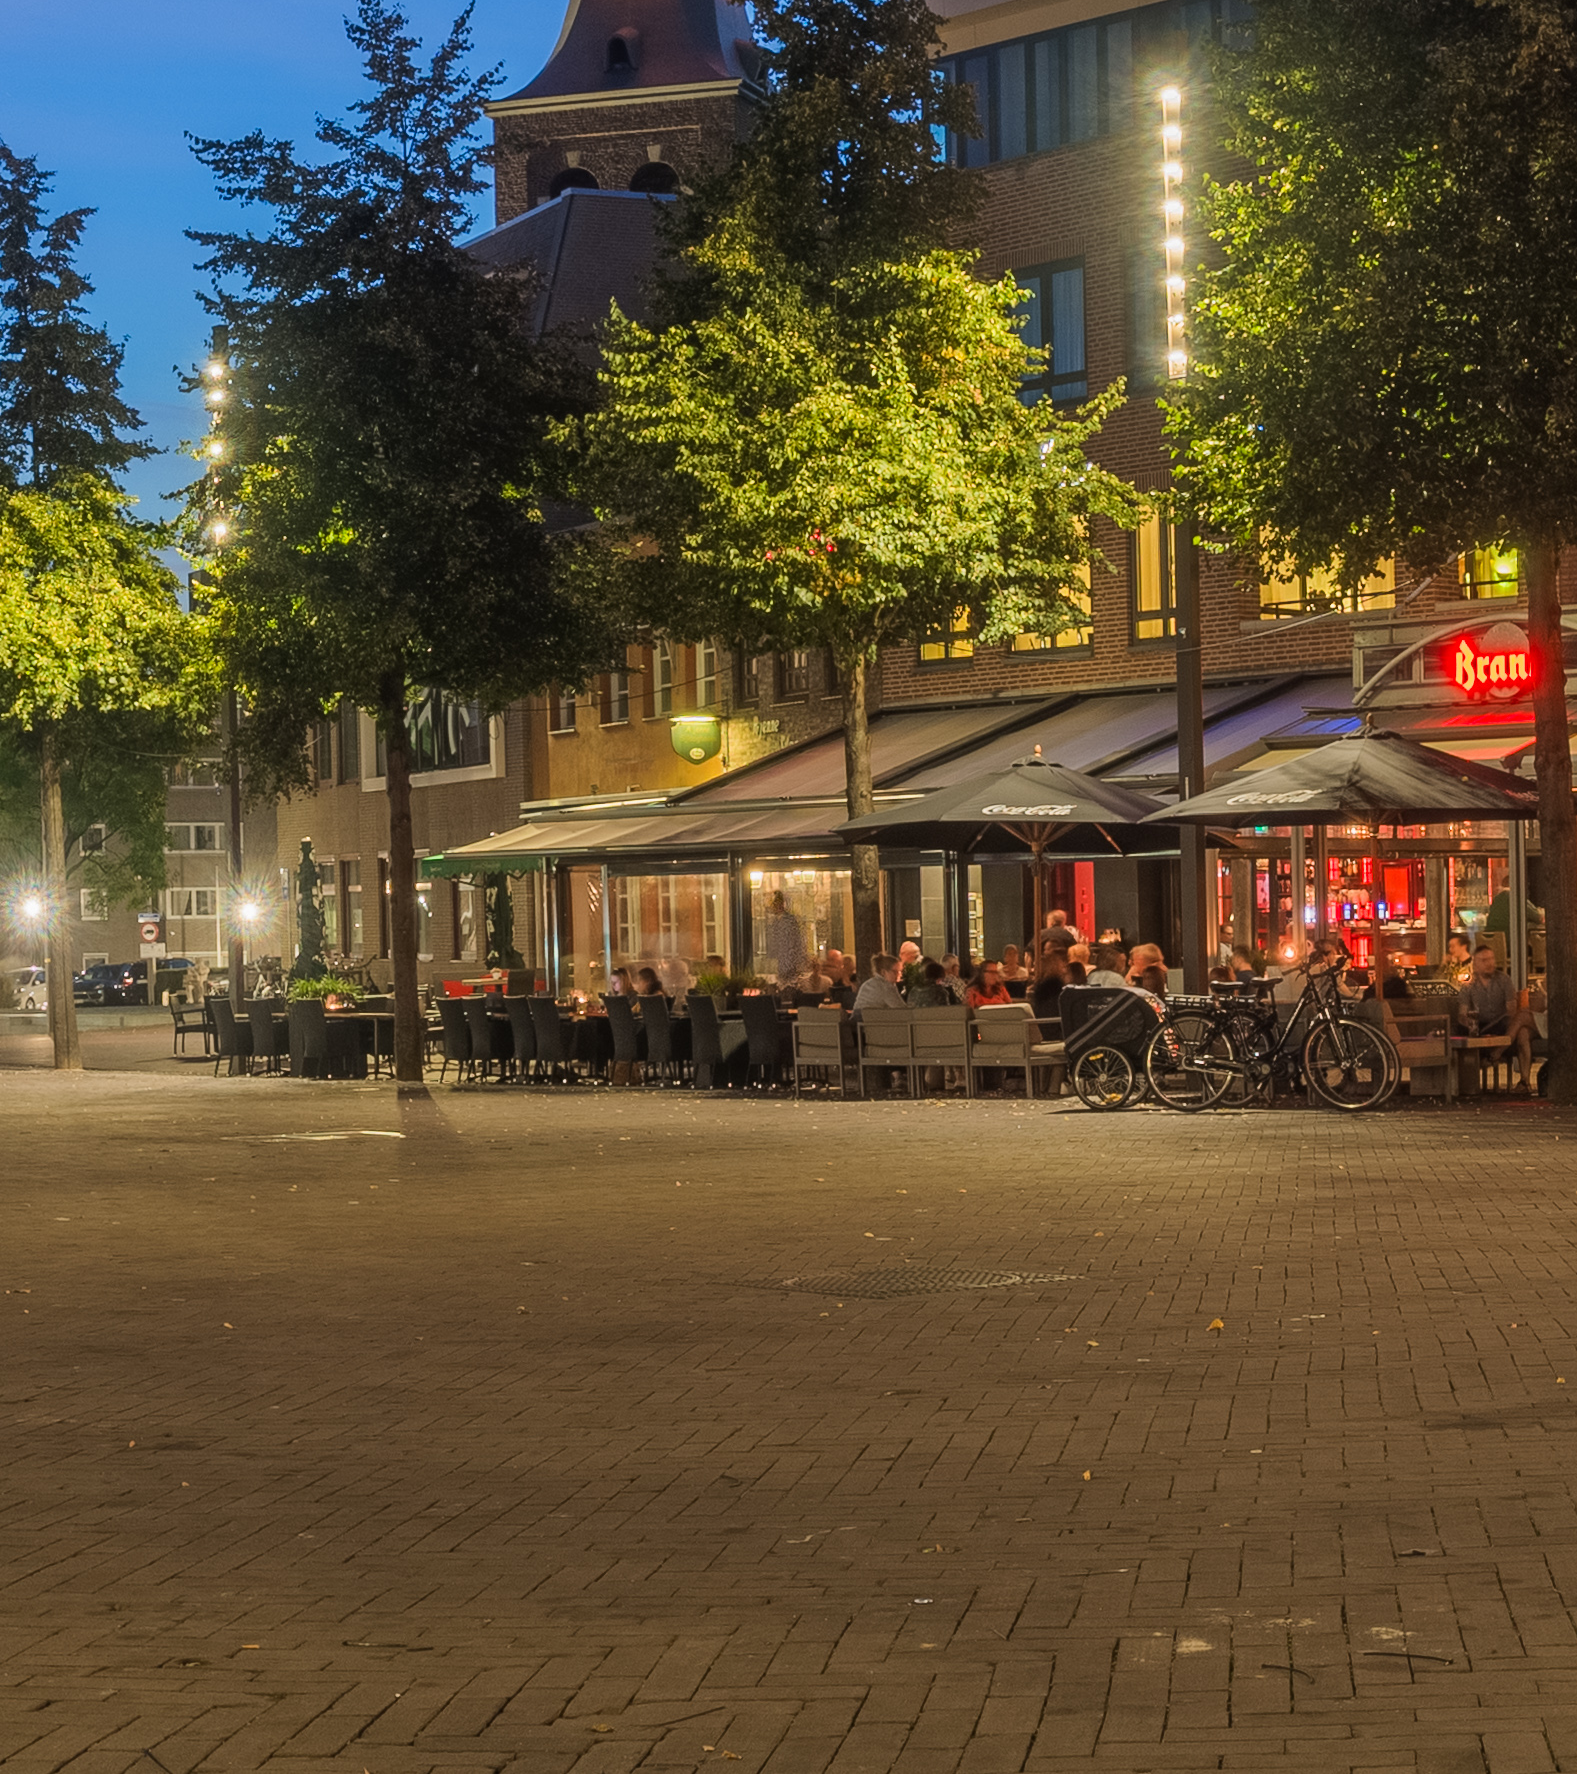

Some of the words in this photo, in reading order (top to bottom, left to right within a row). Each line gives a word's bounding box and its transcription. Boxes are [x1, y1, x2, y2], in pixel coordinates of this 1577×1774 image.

[1455, 639, 1531, 691] Bran
[1226, 788, 1323, 807] Coca-Cola
[981, 803, 1078, 817] Coca-Cola
